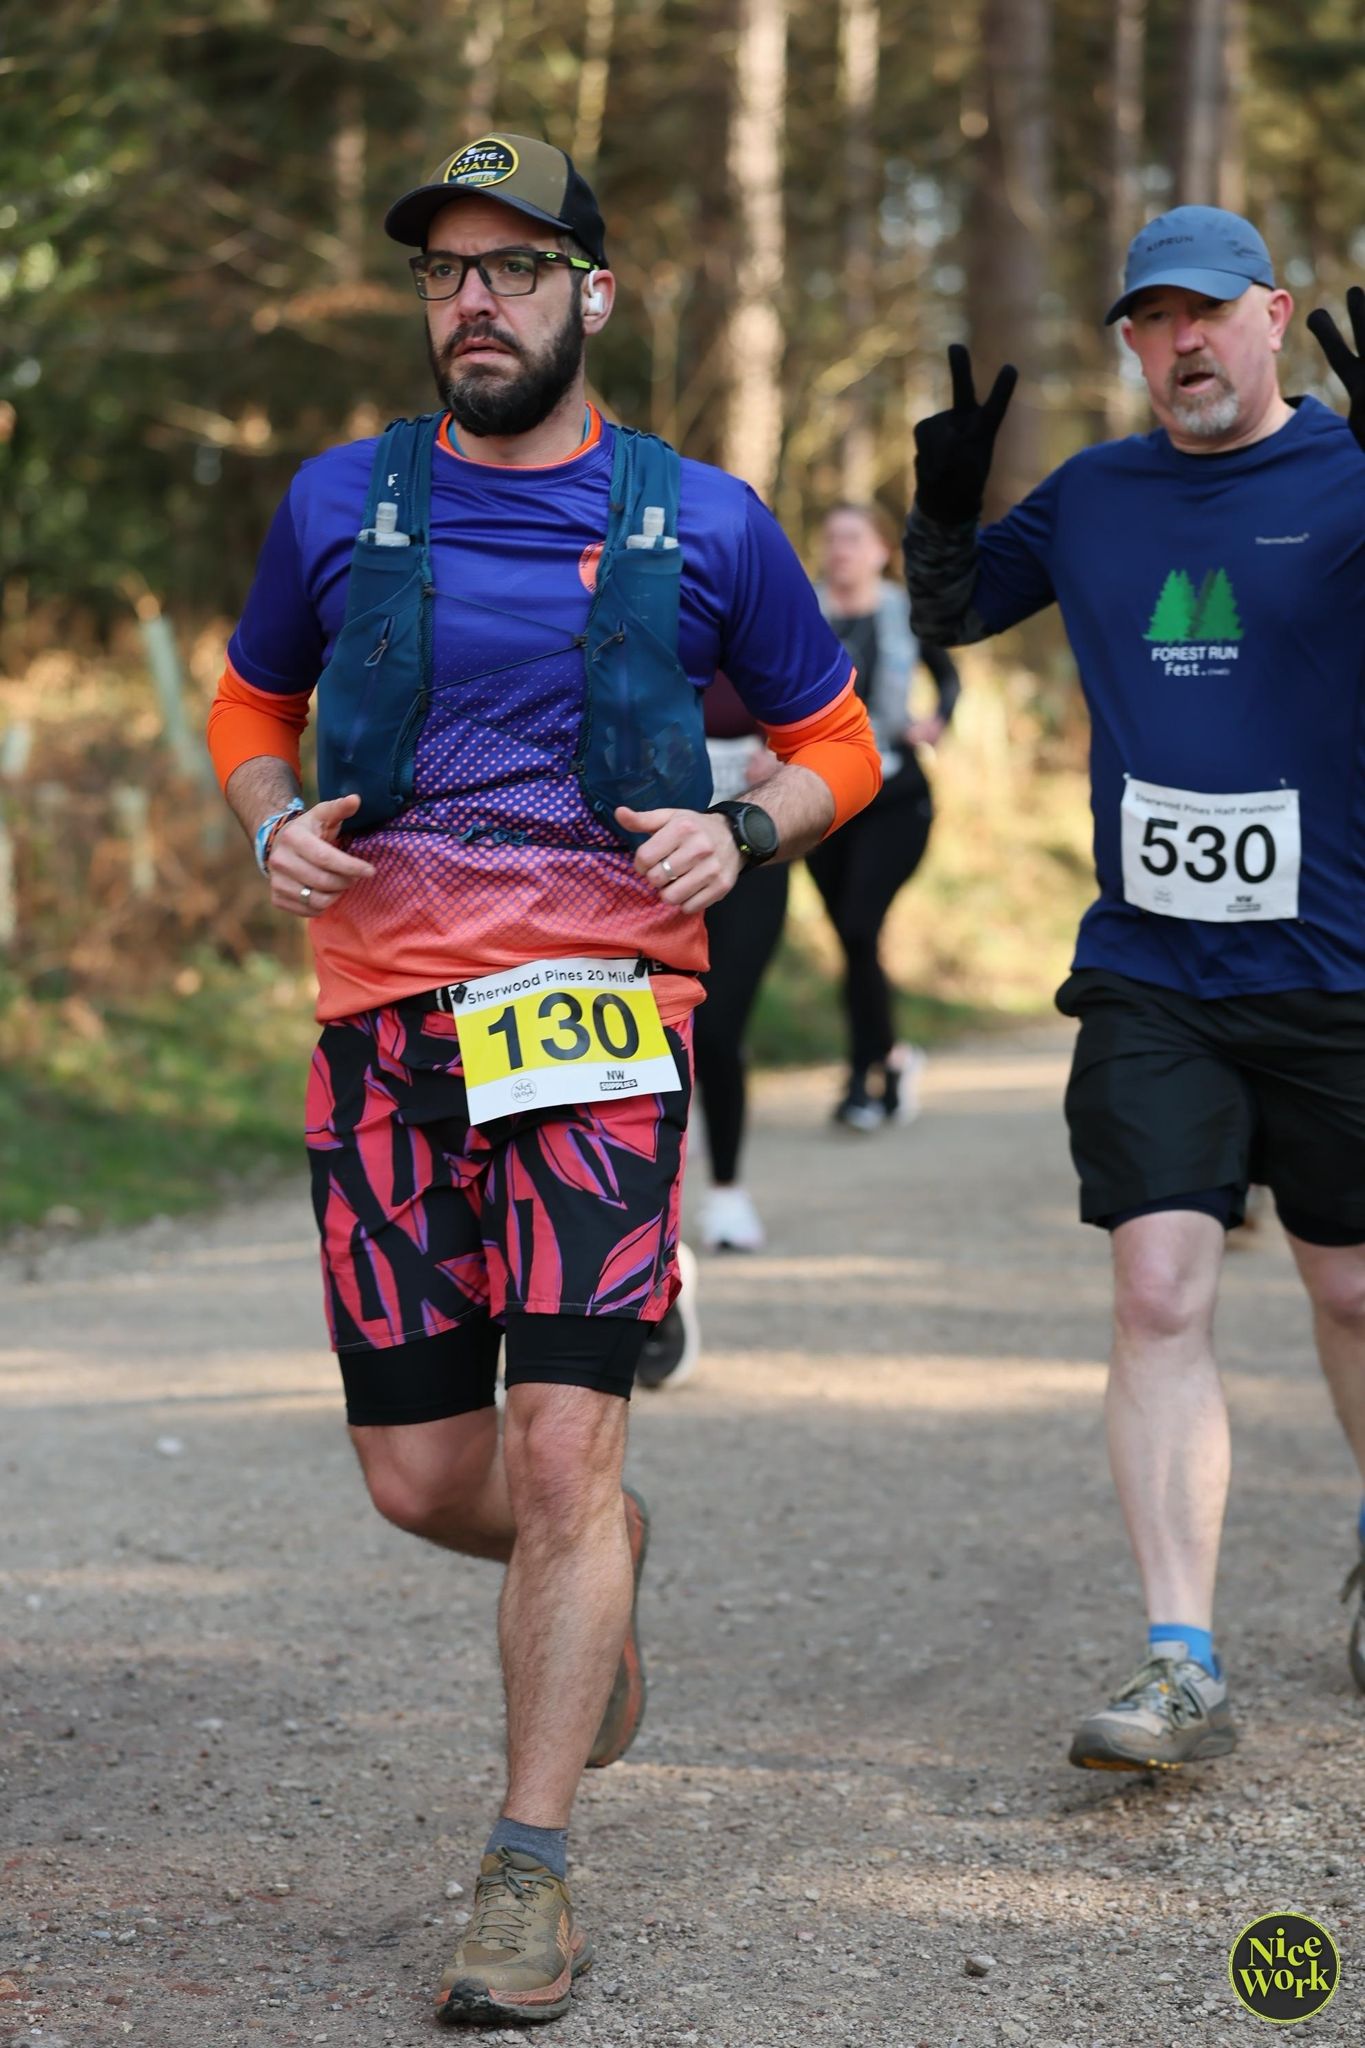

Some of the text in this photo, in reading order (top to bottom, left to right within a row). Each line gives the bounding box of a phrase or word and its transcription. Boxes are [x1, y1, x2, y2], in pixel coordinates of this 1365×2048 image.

[451, 161, 511, 176] WALL
[461, 152, 498, 165] THE
[1151, 645, 1239, 661] FOREST RUN
[1135, 792, 1286, 816] Sherwood Pines Half Marathon
[1140, 816, 1276, 884] 530
[467, 969, 635, 1005] Sherwood Pines 20 Mile
[488, 991, 640, 1070] 130
[606, 1070, 625, 1080] NW
